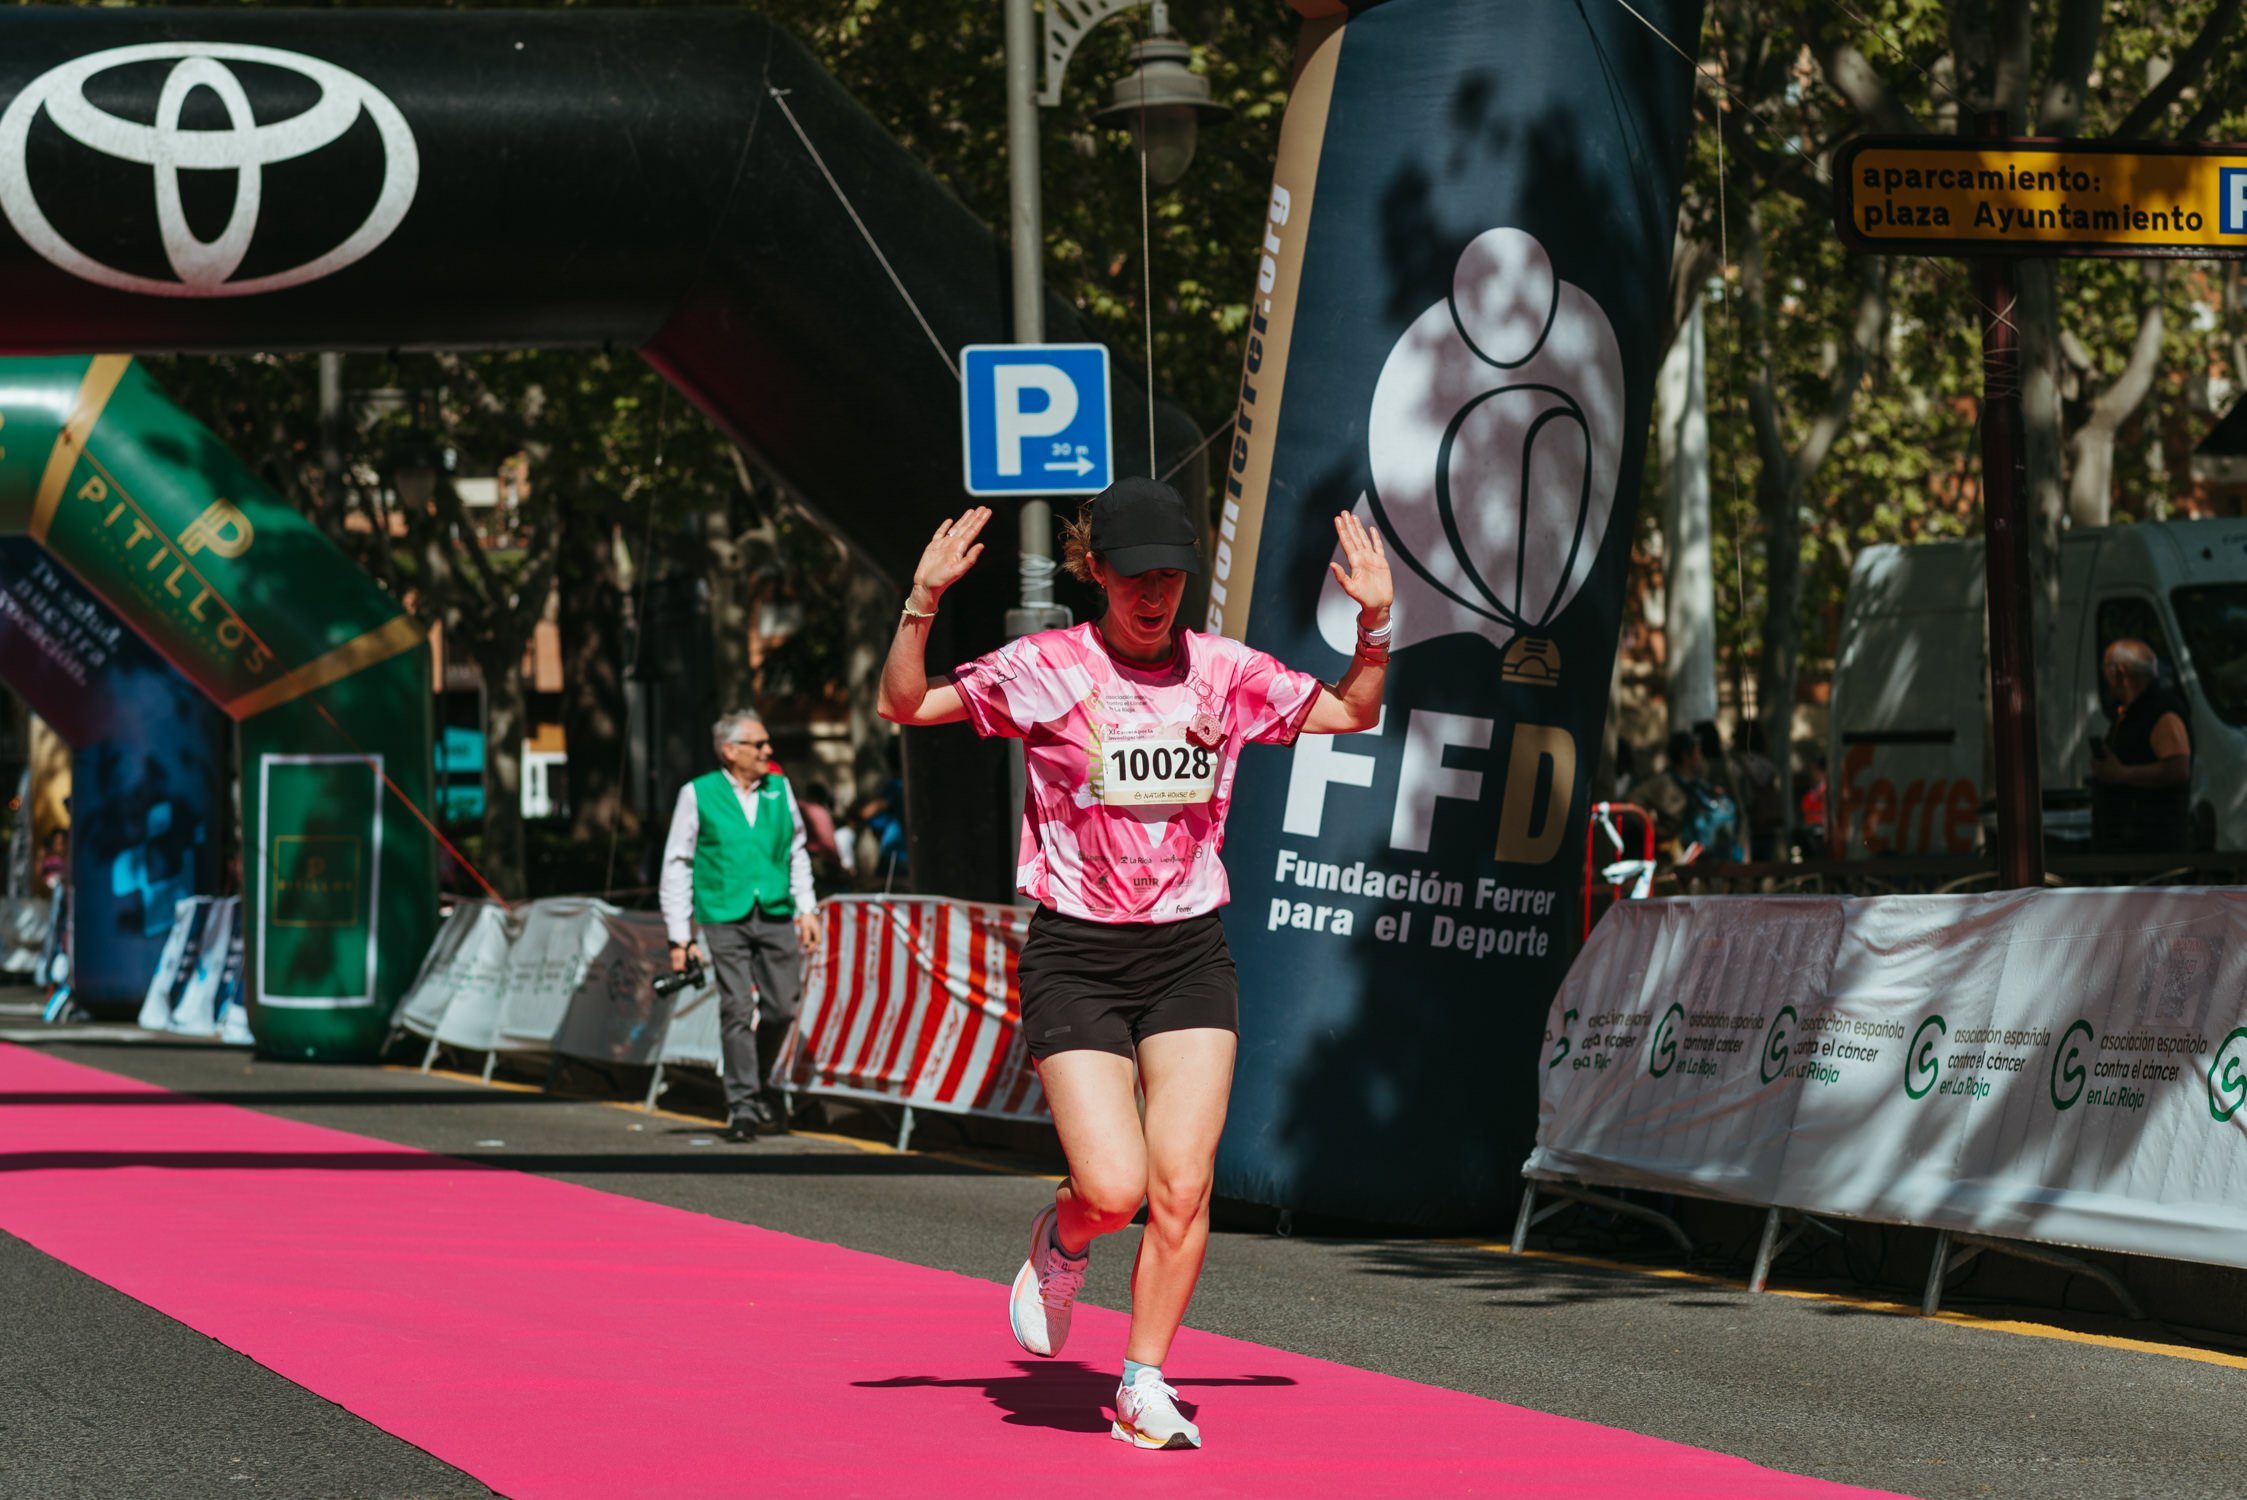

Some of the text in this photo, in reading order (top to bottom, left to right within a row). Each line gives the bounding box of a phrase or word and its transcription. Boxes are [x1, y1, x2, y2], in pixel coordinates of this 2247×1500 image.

[1863, 164, 2101, 195] aparcamiento:
[1864, 199, 2203, 233] plaza Ayuntamiento
[993, 363, 1079, 476] P
[1051, 443, 1071, 456] 30
[77, 475, 266, 672] PITILLOS
[1110, 747, 1210, 781] 10028
[1282, 704, 1577, 865] FFD
[1275, 849, 1556, 916] Fundación Ferrer
[1267, 898, 1549, 959] para el Deporte
[1854, 1020, 1905, 1040] española
[1954, 1024, 2051, 1050] asociación española
[1822, 1038, 1836, 1056] el
[1837, 1041, 1879, 1063] cáncer
[2100, 1031, 2208, 1059] asociación española
[1807, 1061, 1840, 1087] Rioja
[1948, 1050, 2027, 1072] contra el cáncer
[2094, 1059, 2180, 1082] contra el cáncer
[1939, 1076, 1991, 1101] en La Rioja
[2087, 1088, 2145, 1112] en La Rioja
